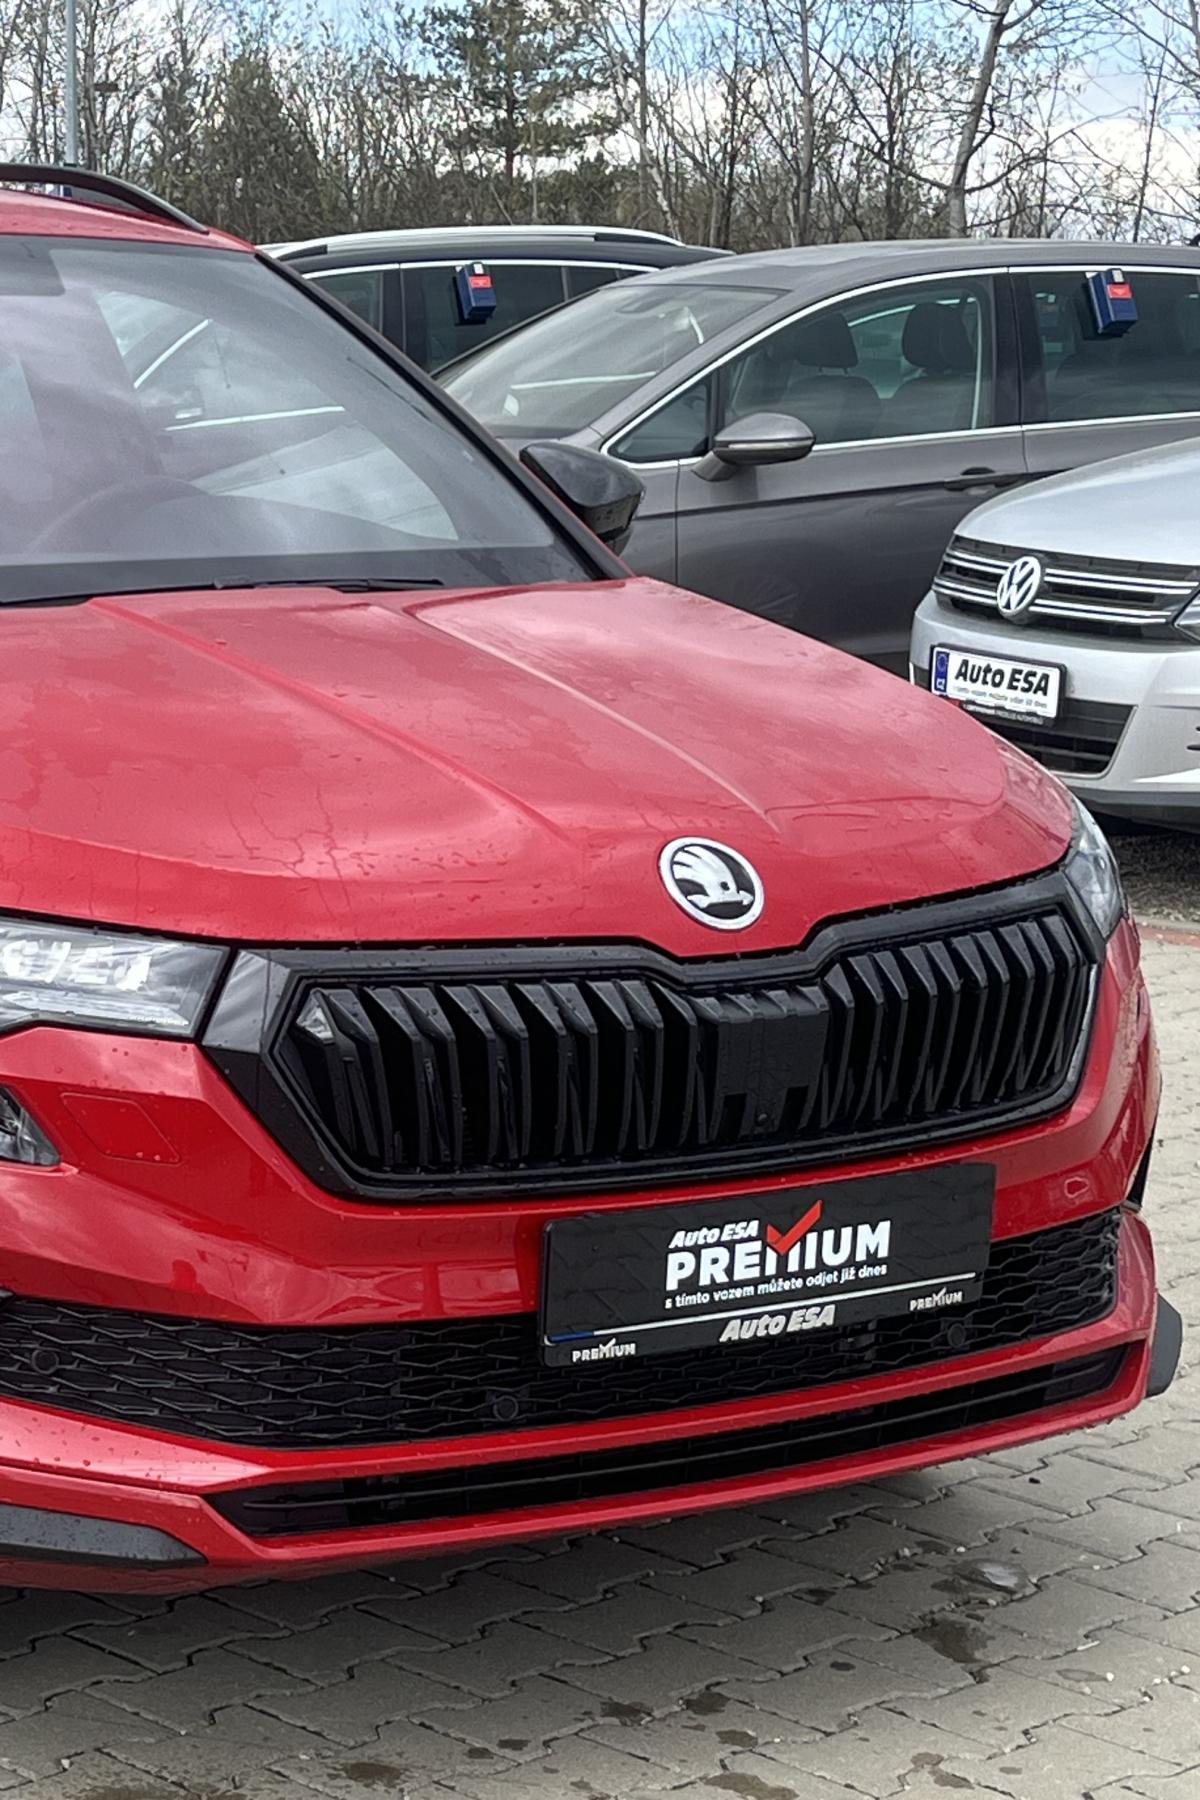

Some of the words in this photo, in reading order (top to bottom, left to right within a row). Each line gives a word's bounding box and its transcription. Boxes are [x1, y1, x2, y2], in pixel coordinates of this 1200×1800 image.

[954, 658, 1005, 689] Auto
[1006, 667, 1051, 697] ESA
[668, 1226, 721, 1250] Auto
[720, 1219, 760, 1242] ESA
[665, 1219, 892, 1292] PREMIUM
[713, 1285, 755, 1302] vozem
[719, 1313, 786, 1343] Auto
[786, 1304, 836, 1333] ESA
[571, 1338, 637, 1363] PREMIUM
